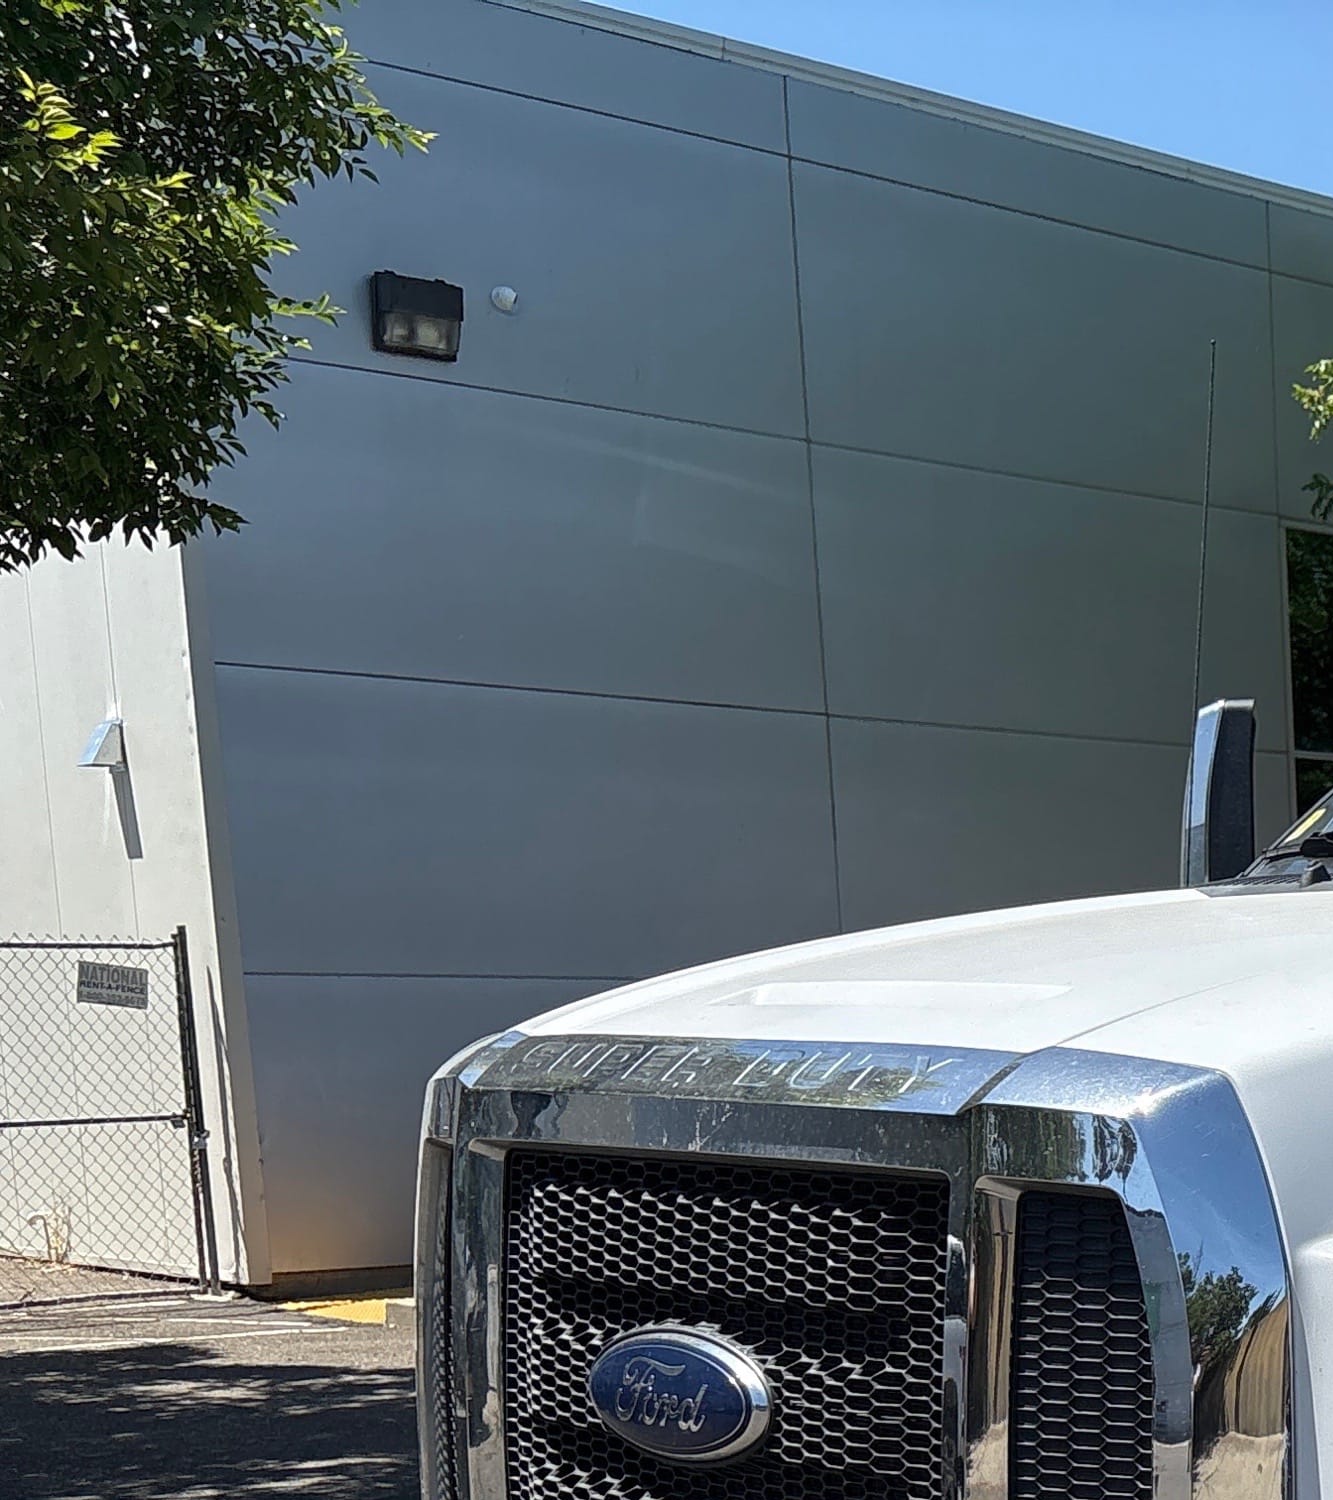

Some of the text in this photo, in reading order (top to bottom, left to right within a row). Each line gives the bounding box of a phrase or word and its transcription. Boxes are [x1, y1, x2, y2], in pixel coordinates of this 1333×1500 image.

[80, 965, 145, 986] NATIONAL
[80, 980, 146, 995] RENT-A-FENCE
[511, 1041, 965, 1094] SUPER DUTY
[615, 1356, 710, 1433] Ford
